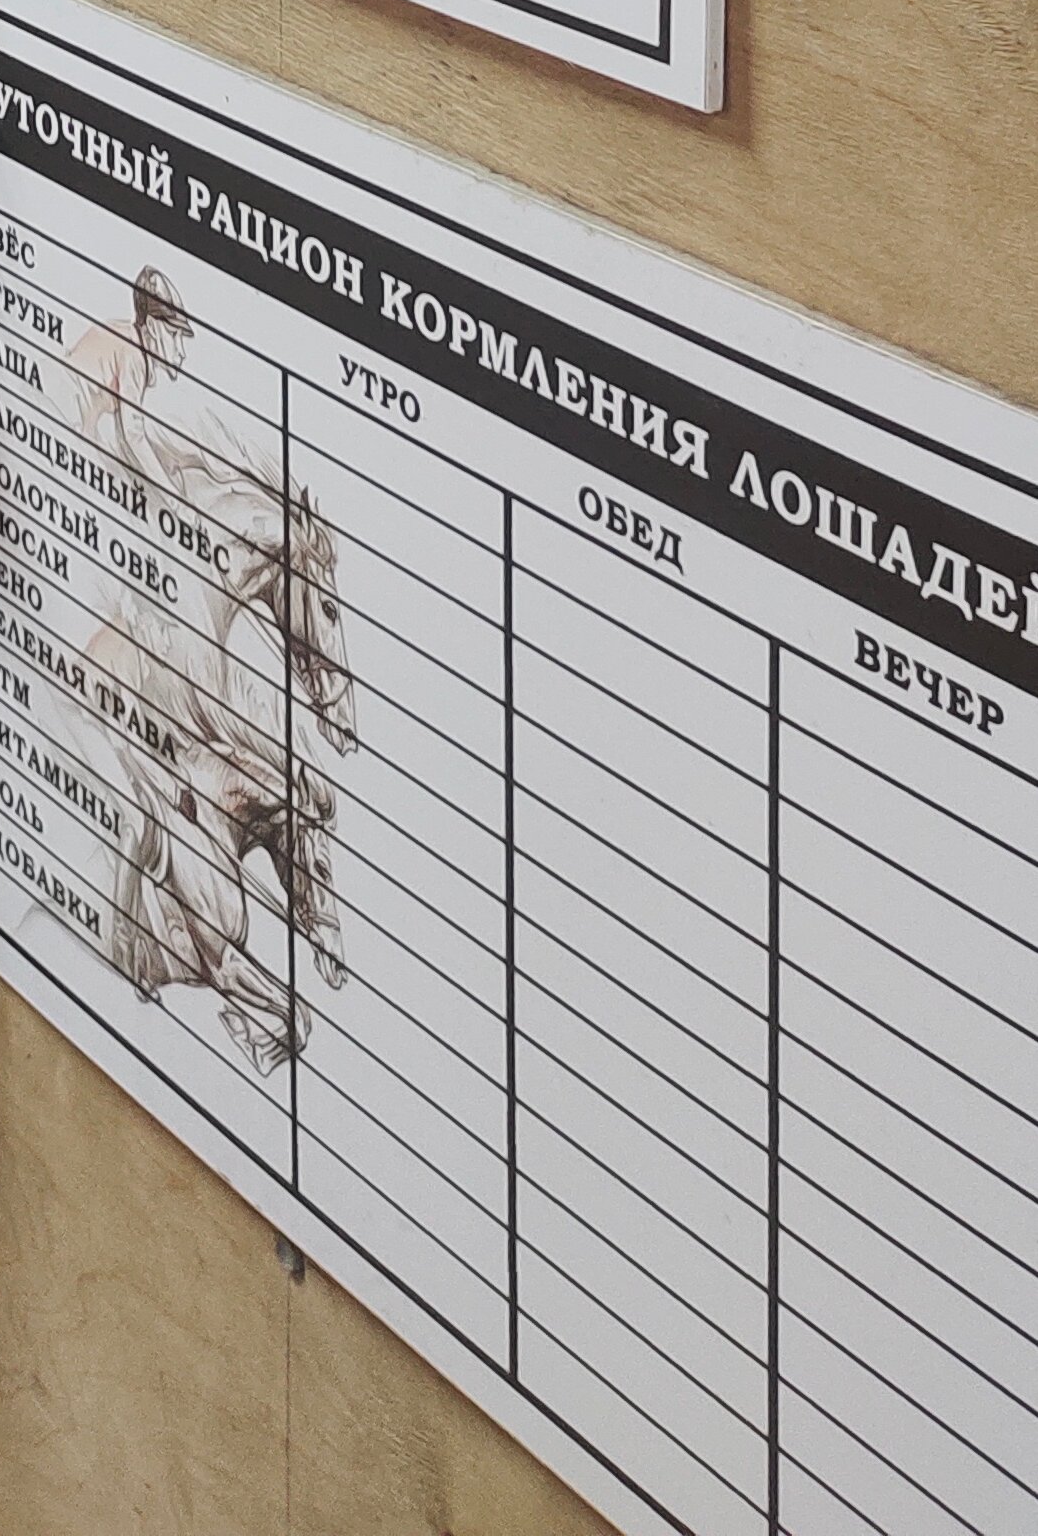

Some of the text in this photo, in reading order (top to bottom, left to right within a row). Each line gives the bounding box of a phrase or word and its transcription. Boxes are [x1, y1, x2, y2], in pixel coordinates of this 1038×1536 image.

[187, 176, 364, 305] РАЦИОН
[380, 271, 710, 480] КОРМЛЕНИЯ
[338, 353, 422, 424] УТРО
[109, 540, 179, 603] ОВЁС
[158, 509, 231, 574] ОВЁС
[578, 485, 685, 576] ОБЕД
[854, 629, 1005, 736] ВЕЧЕР
[96, 683, 178, 765] ТРАВА
